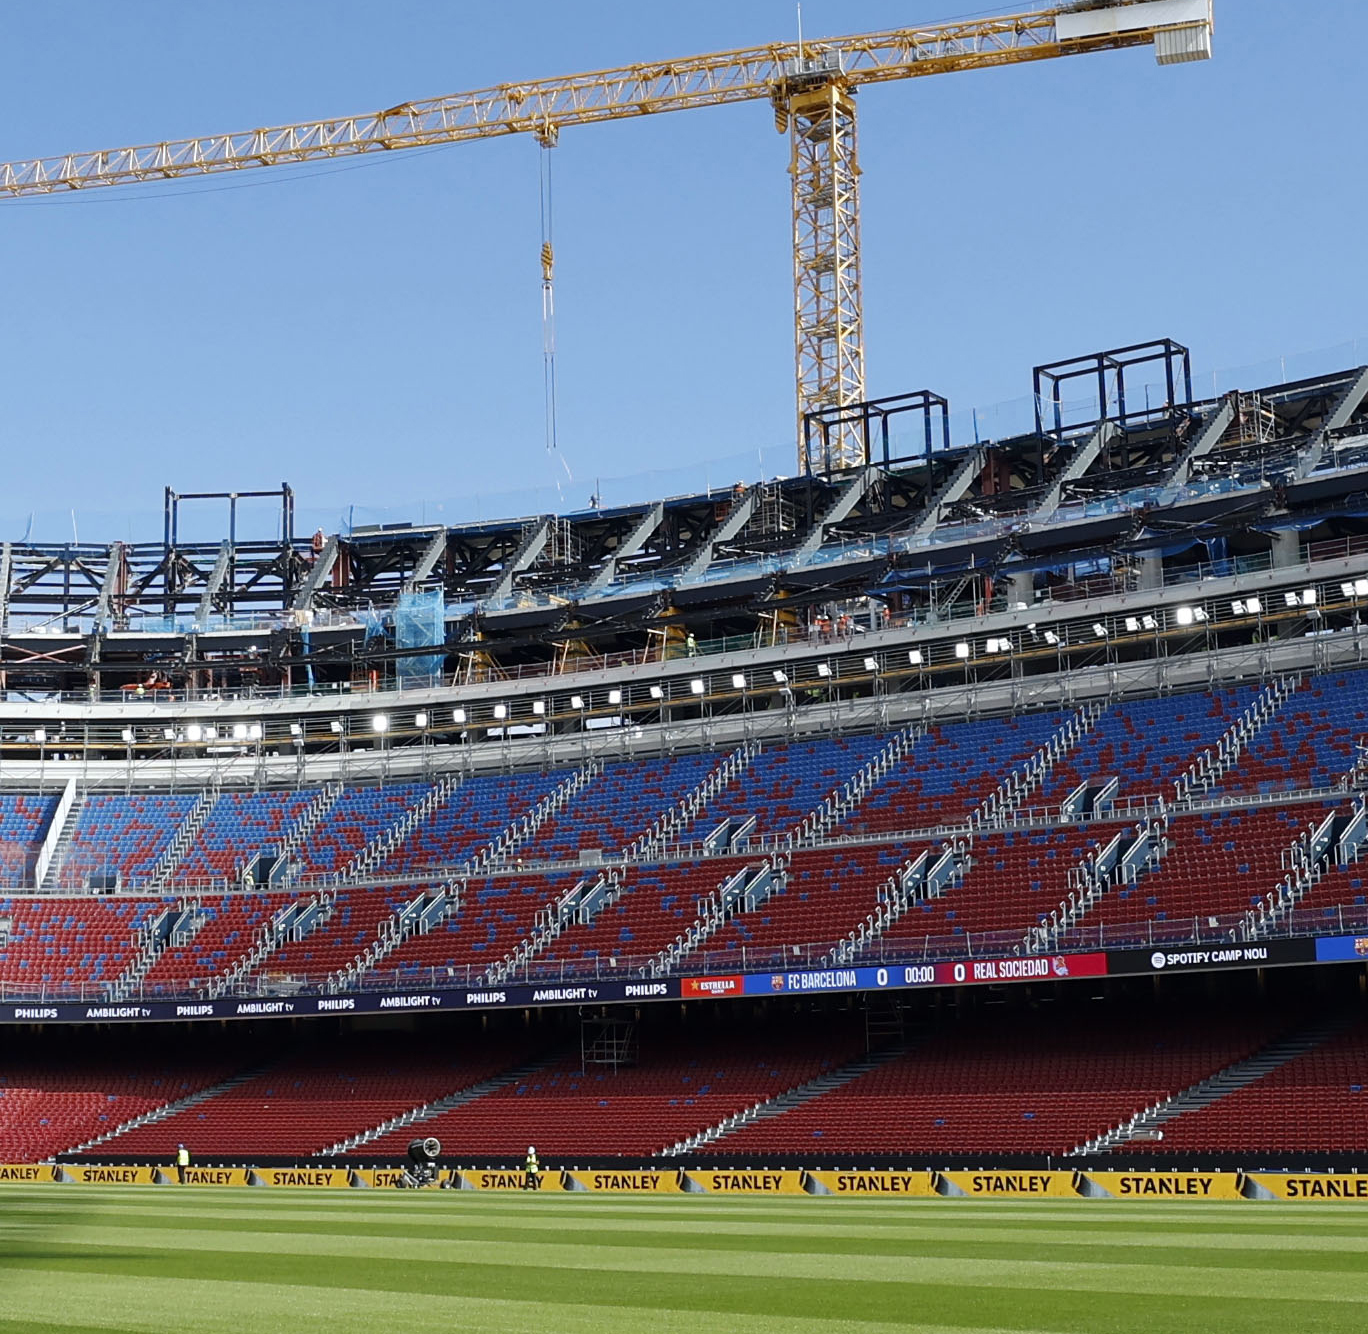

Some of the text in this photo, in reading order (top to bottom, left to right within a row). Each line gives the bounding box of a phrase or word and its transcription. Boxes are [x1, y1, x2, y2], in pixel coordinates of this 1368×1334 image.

[1166, 948, 1267, 965] SPOTIFY CAMP NOU
[788, 959, 1048, 988] FC BARCELONA 0 00:00 0 REAL SOCIEDAD
[626, 984, 667, 996] PHILIPS
[700, 980, 735, 990] ESTRELLA
[467, 992, 505, 1003] PHILIPS
[533, 988, 597, 1000] AMBILIGHT tv
[319, 999, 354, 1010] PHILIPS
[380, 996, 441, 1007] AMBILIGHT tv
[15, 1009, 57, 1018] PHILIPS
[87, 1008, 140, 1017] AMBILIGHT
[177, 1005, 213, 1015] PHILIPS
[237, 1003, 284, 1013] AMBILIGHT
[83, 1170, 137, 1182] STANLEY
[185, 1171, 232, 1184] TANLEY
[274, 1173, 332, 1185] STANLEY
[481, 1174, 544, 1188] STANLY
[595, 1175, 659, 1189] STANLEY
[713, 1175, 782, 1189] STANLEY
[838, 1176, 911, 1191] STANLEY
[973, 1176, 1051, 1191] STANLEY
[1121, 1178, 1212, 1194] STANLEY
